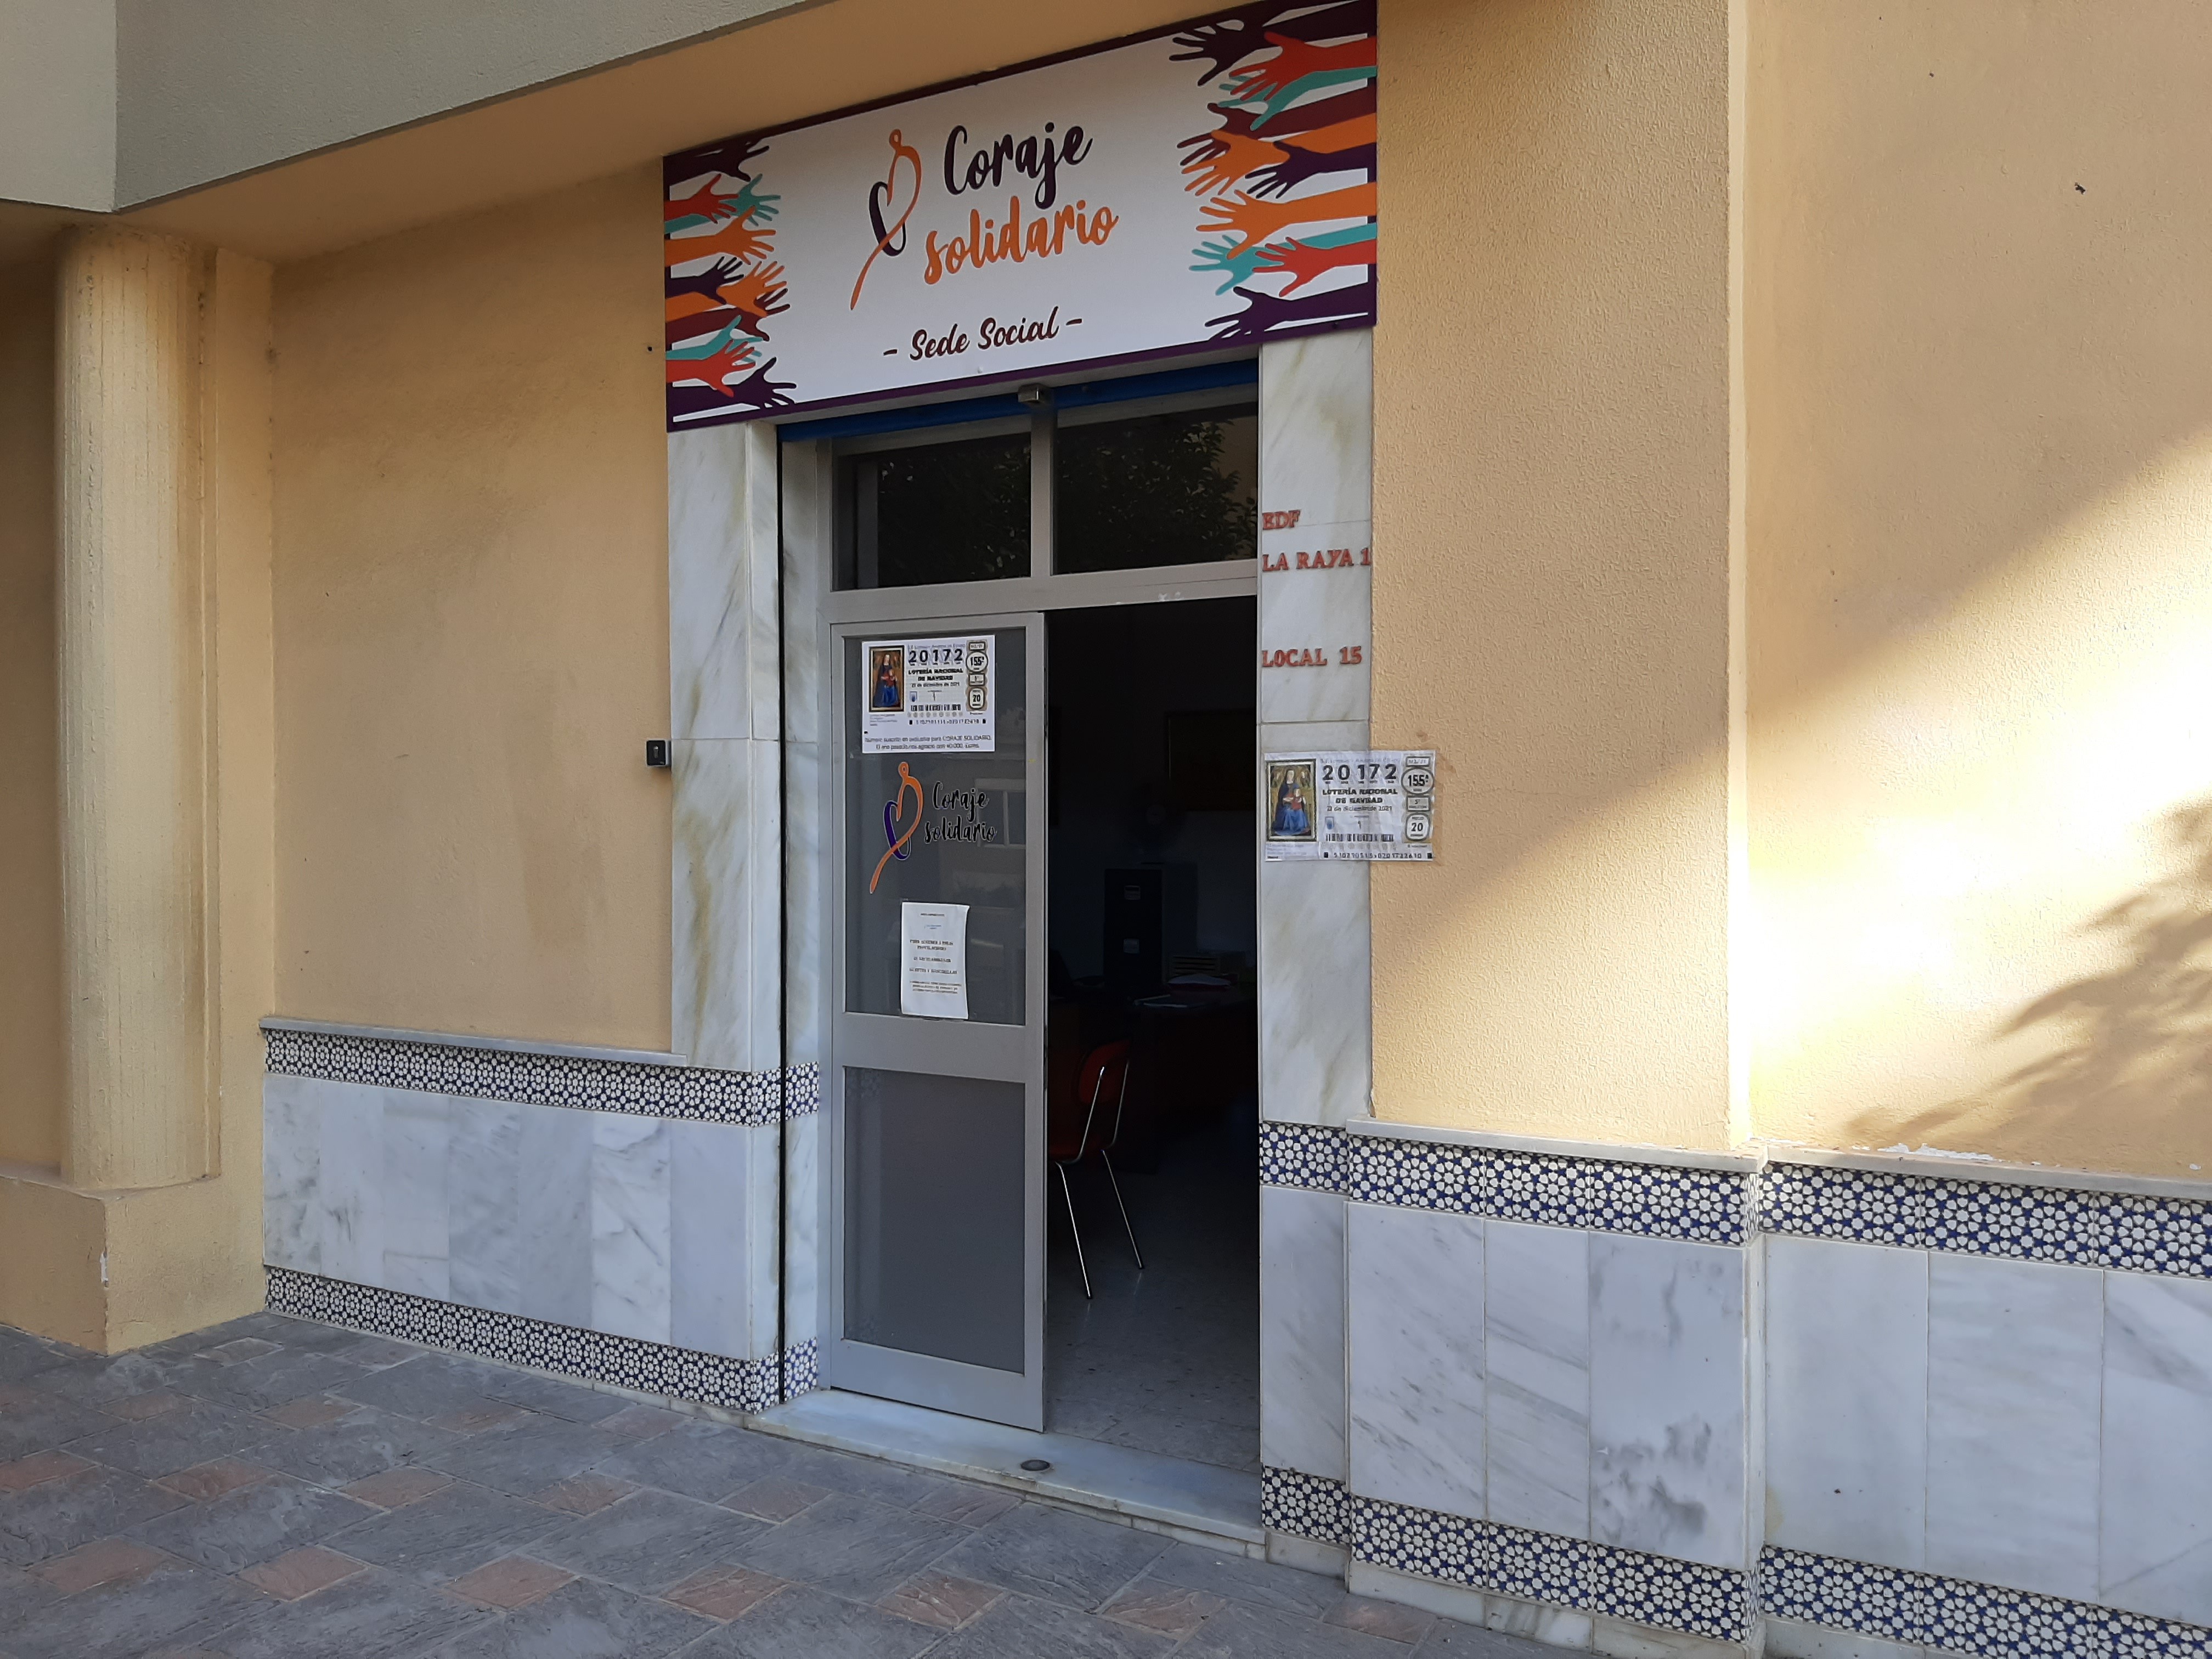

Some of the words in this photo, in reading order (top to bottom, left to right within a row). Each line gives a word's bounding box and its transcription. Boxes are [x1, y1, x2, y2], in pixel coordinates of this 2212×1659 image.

[944, 122, 1093, 210] Coraje
[924, 195, 1119, 285] solidario
[909, 323, 970, 361] Sede
[977, 306, 1059, 350] Social
[1262, 509, 1301, 530] EDF
[1262, 552, 1289, 572] LA
[1296, 549, 1355, 569] RAYA
[1360, 547, 1371, 566] 1
[909, 648, 963, 663] 20172
[1261, 648, 1328, 667] LOCAL
[1339, 646, 1363, 665] 15
[1322, 763, 1397, 780] 20172
[932, 781, 989, 822] Coraje
[1411, 823, 1424, 832] 20
